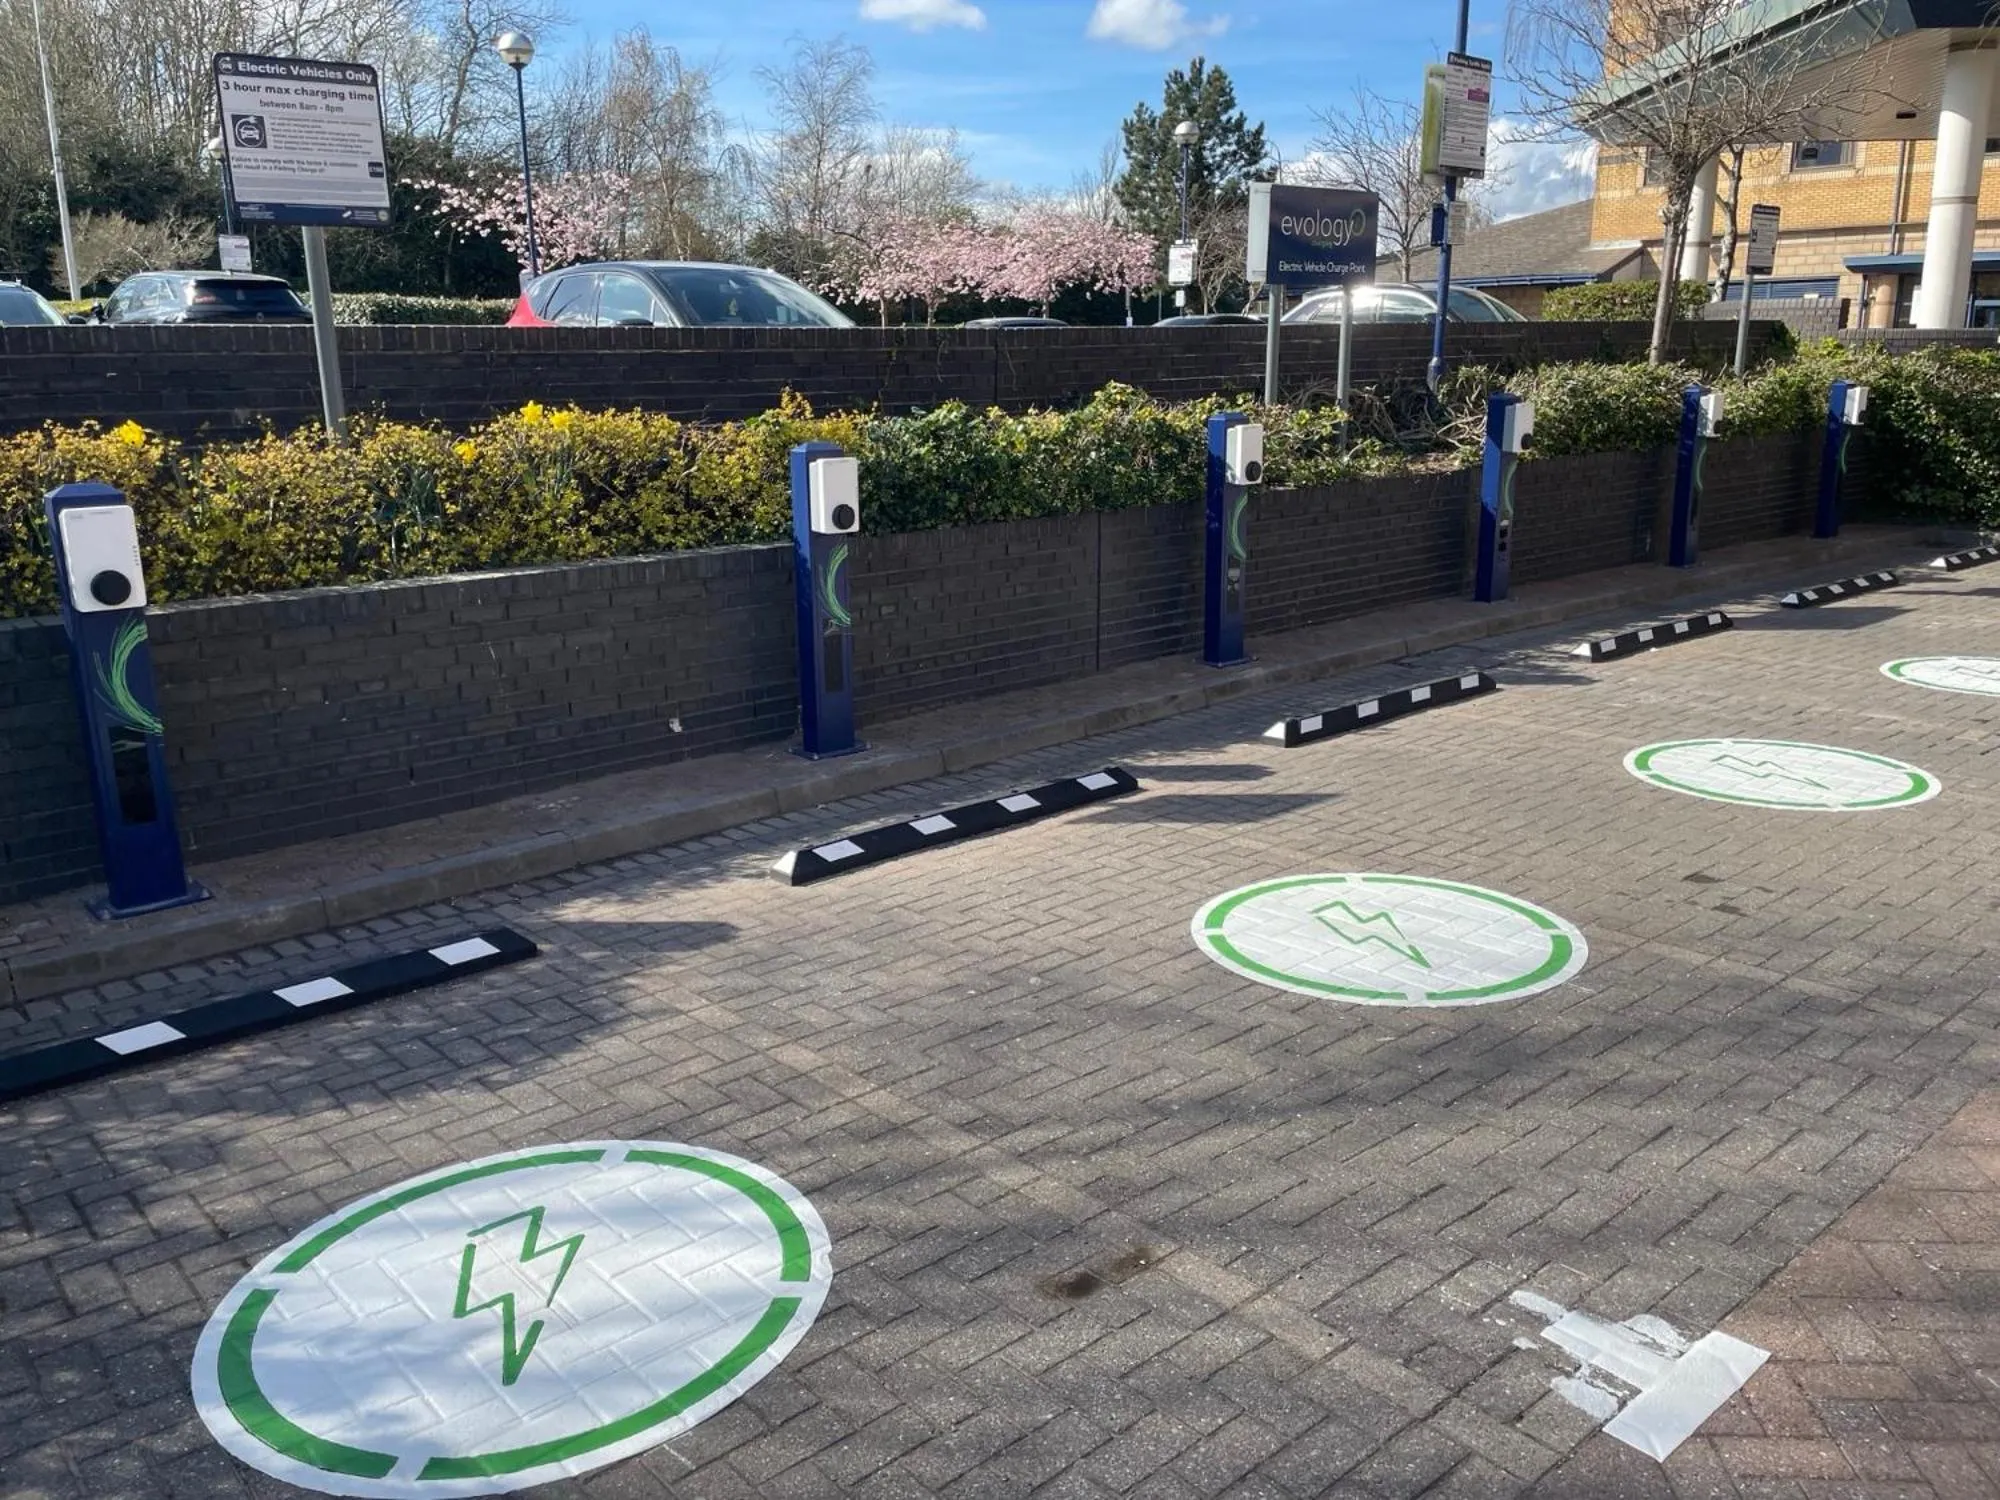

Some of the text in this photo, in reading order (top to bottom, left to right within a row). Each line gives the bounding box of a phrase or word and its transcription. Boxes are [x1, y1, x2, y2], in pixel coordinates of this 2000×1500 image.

[237, 61, 373, 83] Electric Vehicles Only
[222, 81, 375, 101] 3 hour max charging time
[260, 99, 297, 110] between
[325, 104, 344, 113] 8pm
[1281, 208, 1354, 246] evology
[1279, 260, 1366, 275] Electric Vehicle Charge Point
